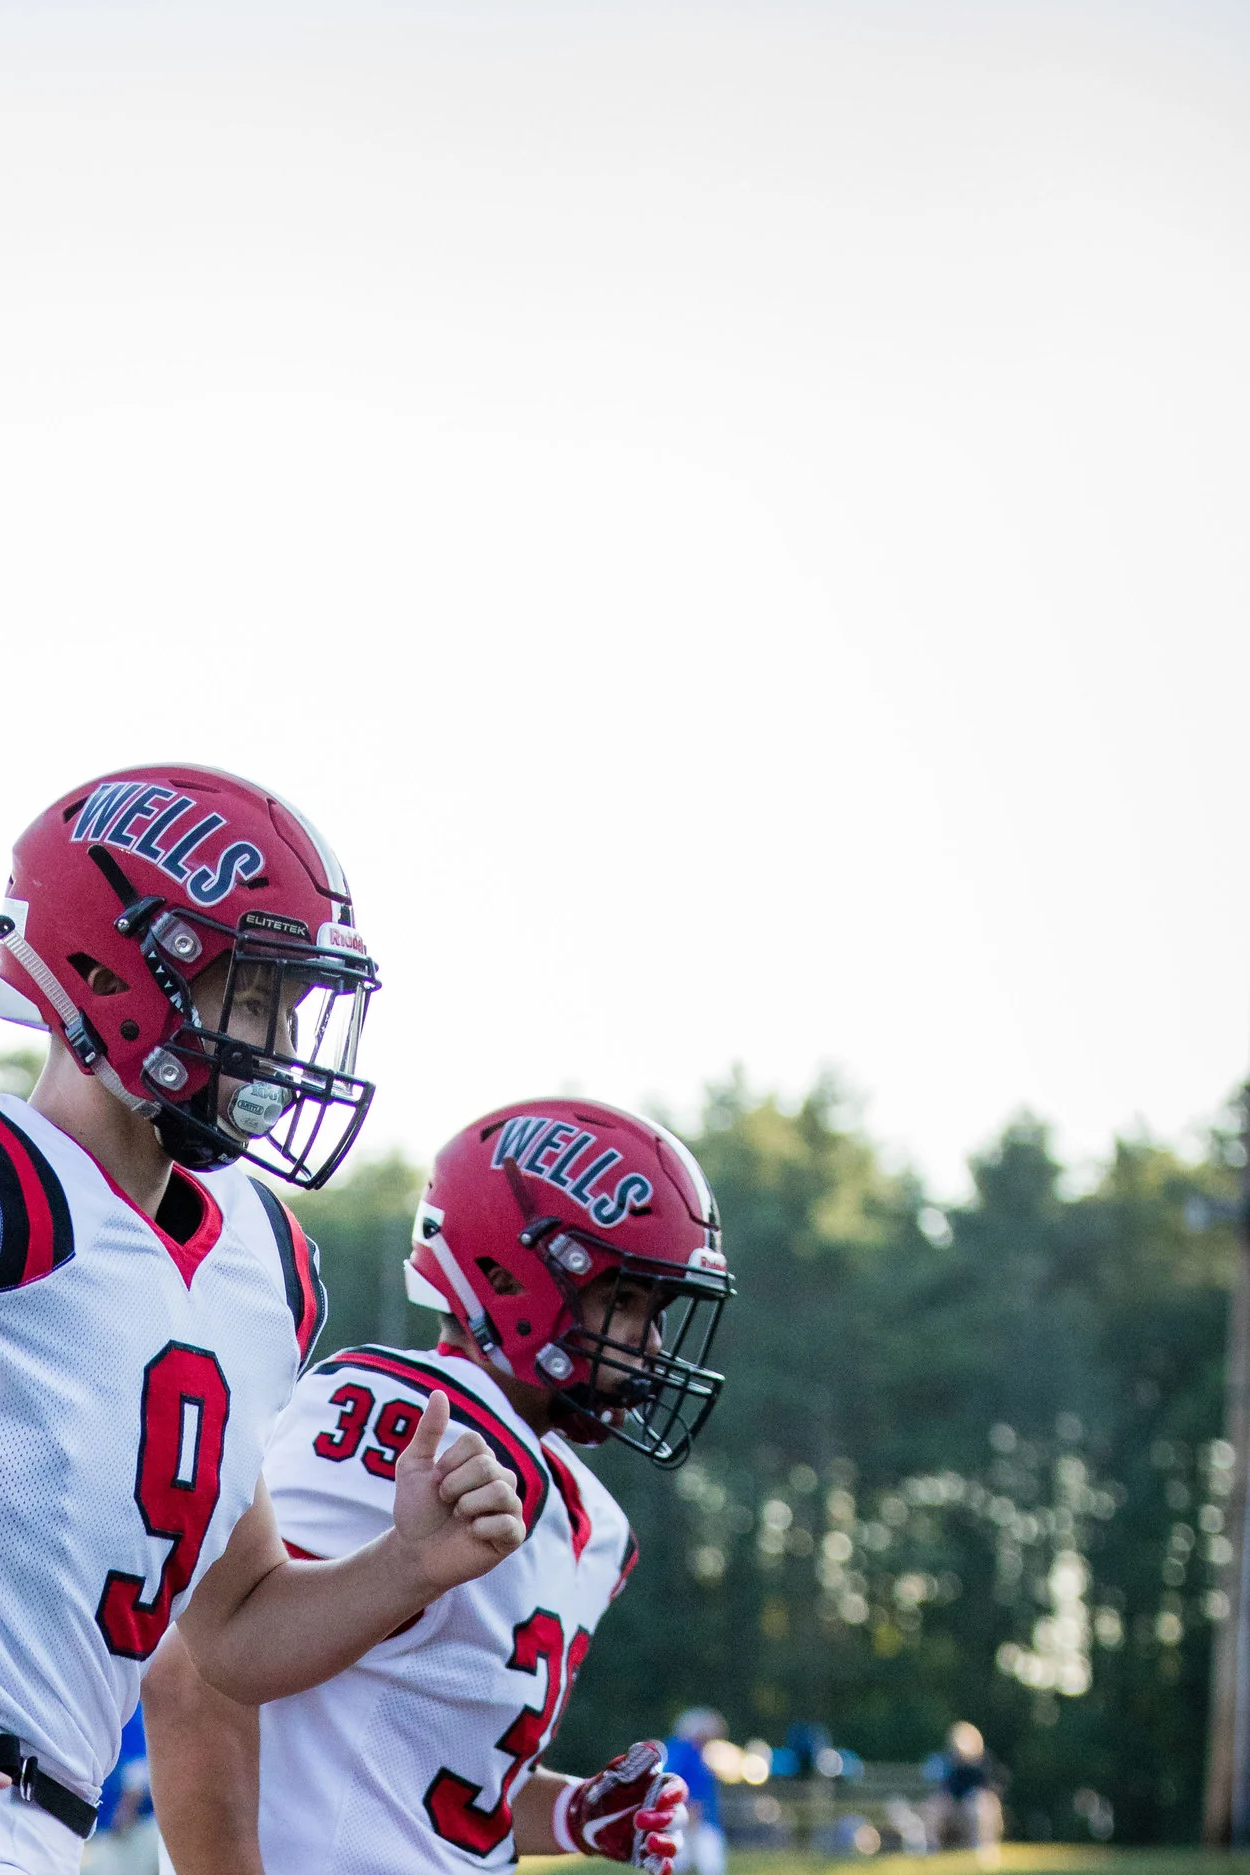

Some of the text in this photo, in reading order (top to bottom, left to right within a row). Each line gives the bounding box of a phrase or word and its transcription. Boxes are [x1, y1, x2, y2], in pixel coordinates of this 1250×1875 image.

[70, 780, 264, 908] WELLS
[246, 914, 307, 936] ELITETEK
[490, 1115, 654, 1228] WELLS
[313, 1383, 423, 1482] 39
[96, 1339, 231, 1661] 9
